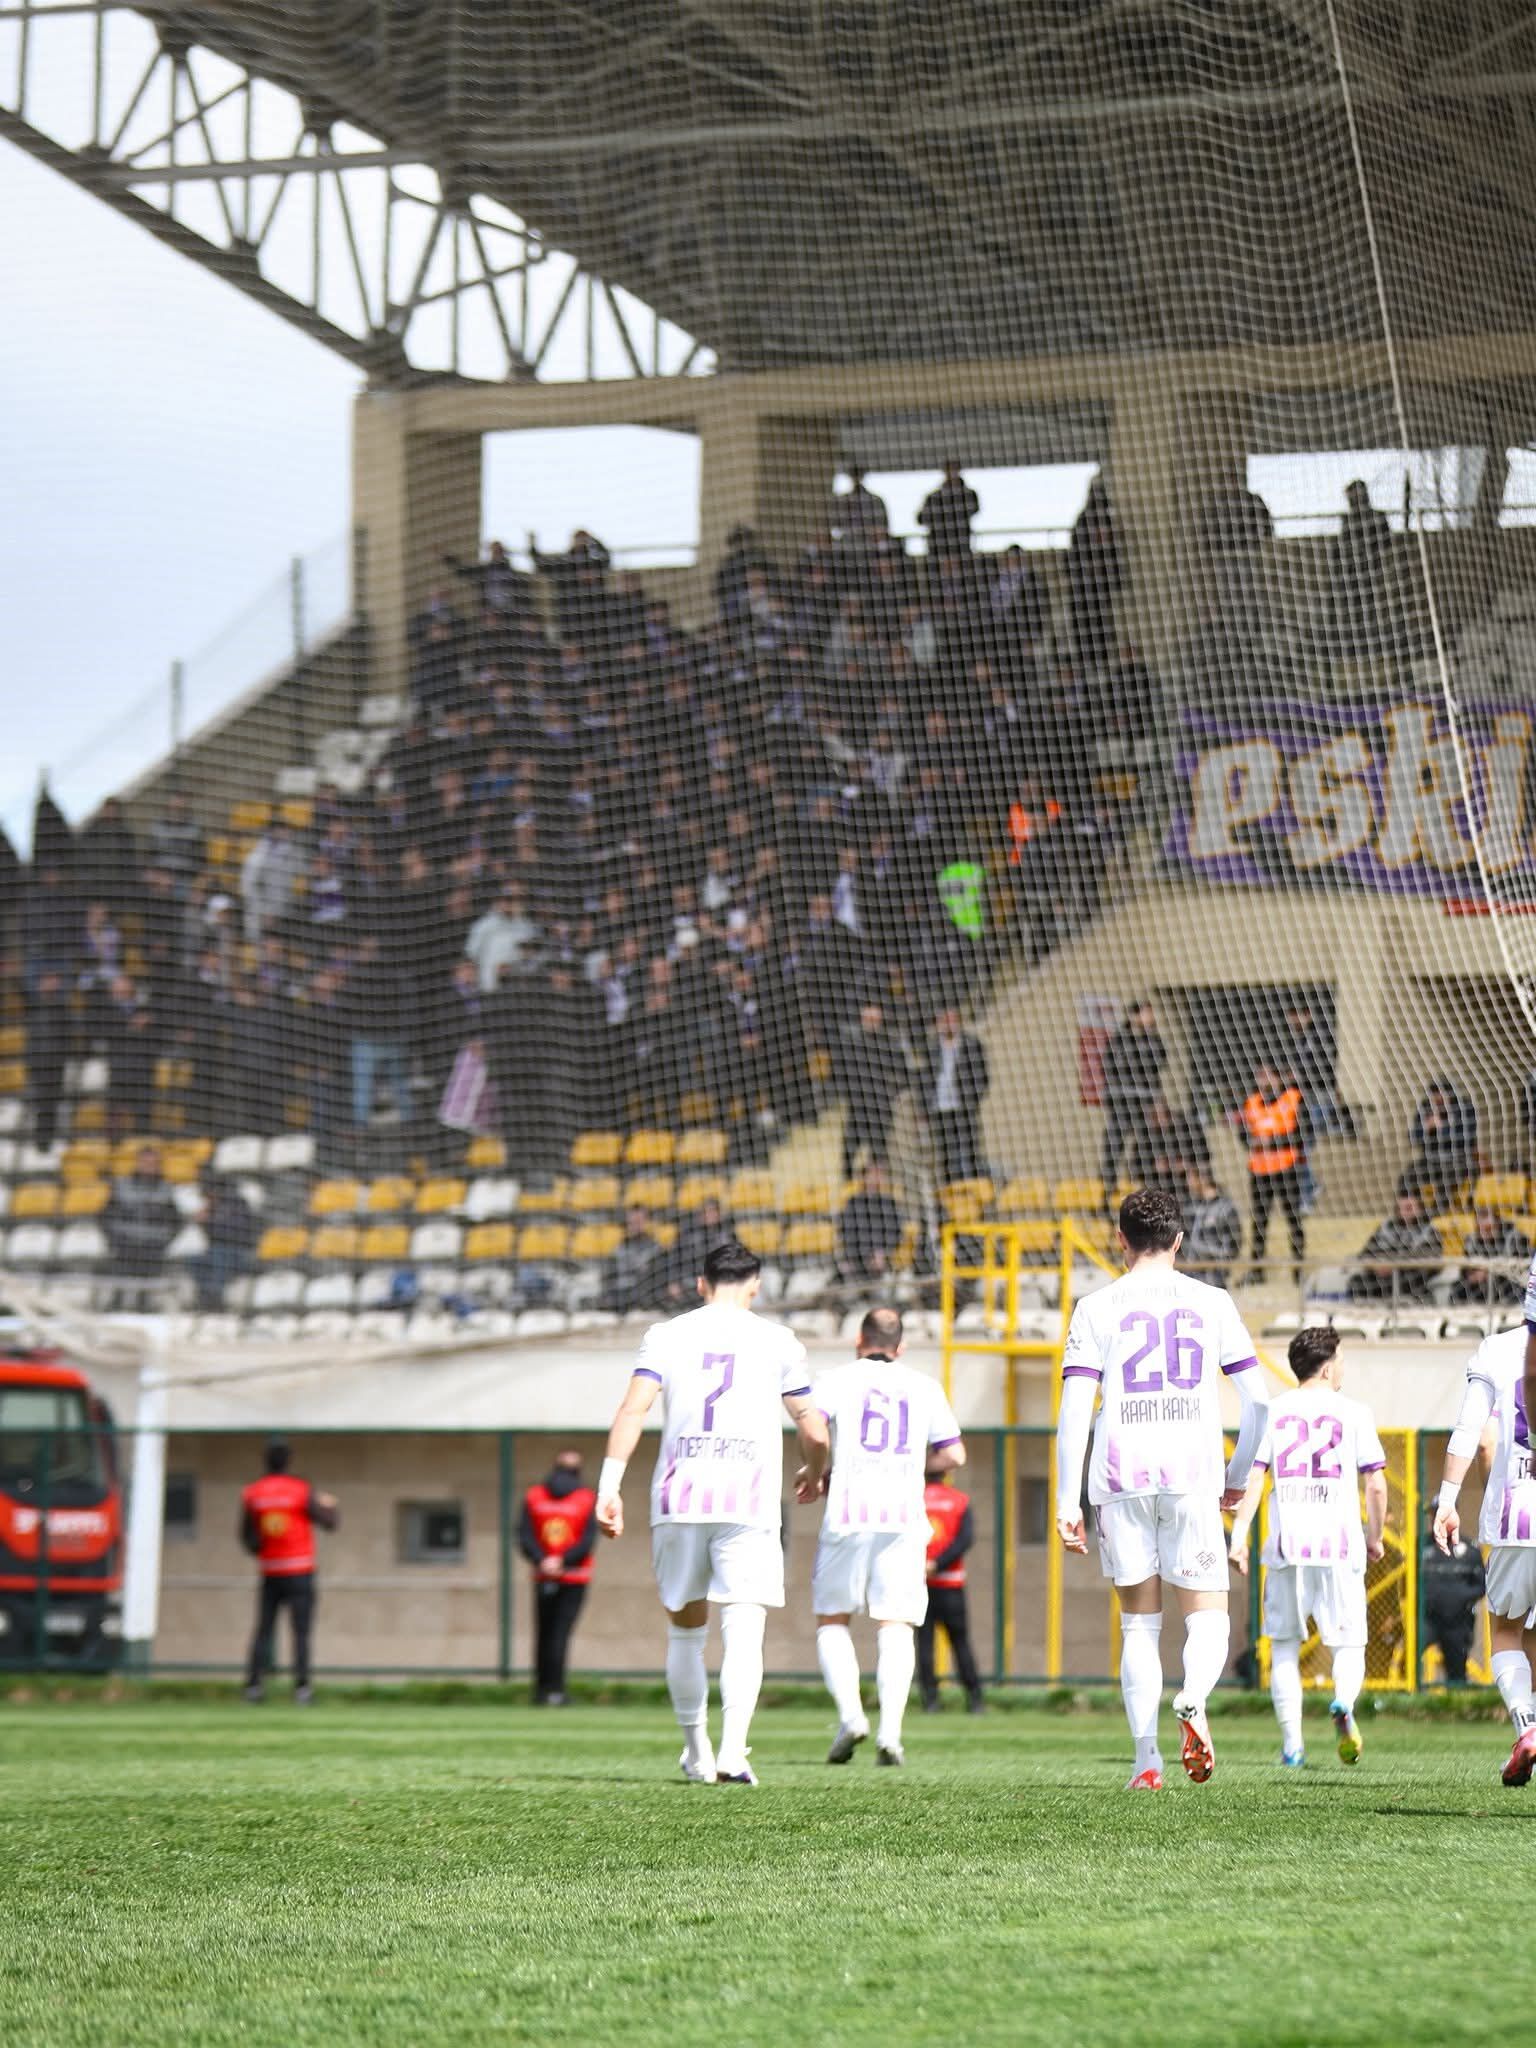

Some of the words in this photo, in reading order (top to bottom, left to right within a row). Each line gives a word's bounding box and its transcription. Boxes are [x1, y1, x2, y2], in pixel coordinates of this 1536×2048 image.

[1120, 1308, 1204, 1394] 26
[702, 1352, 736, 1432] 7
[860, 1387, 912, 1455] 61
[1120, 1399, 1158, 1424] KAAN
[1275, 1415, 1343, 1479] 22
